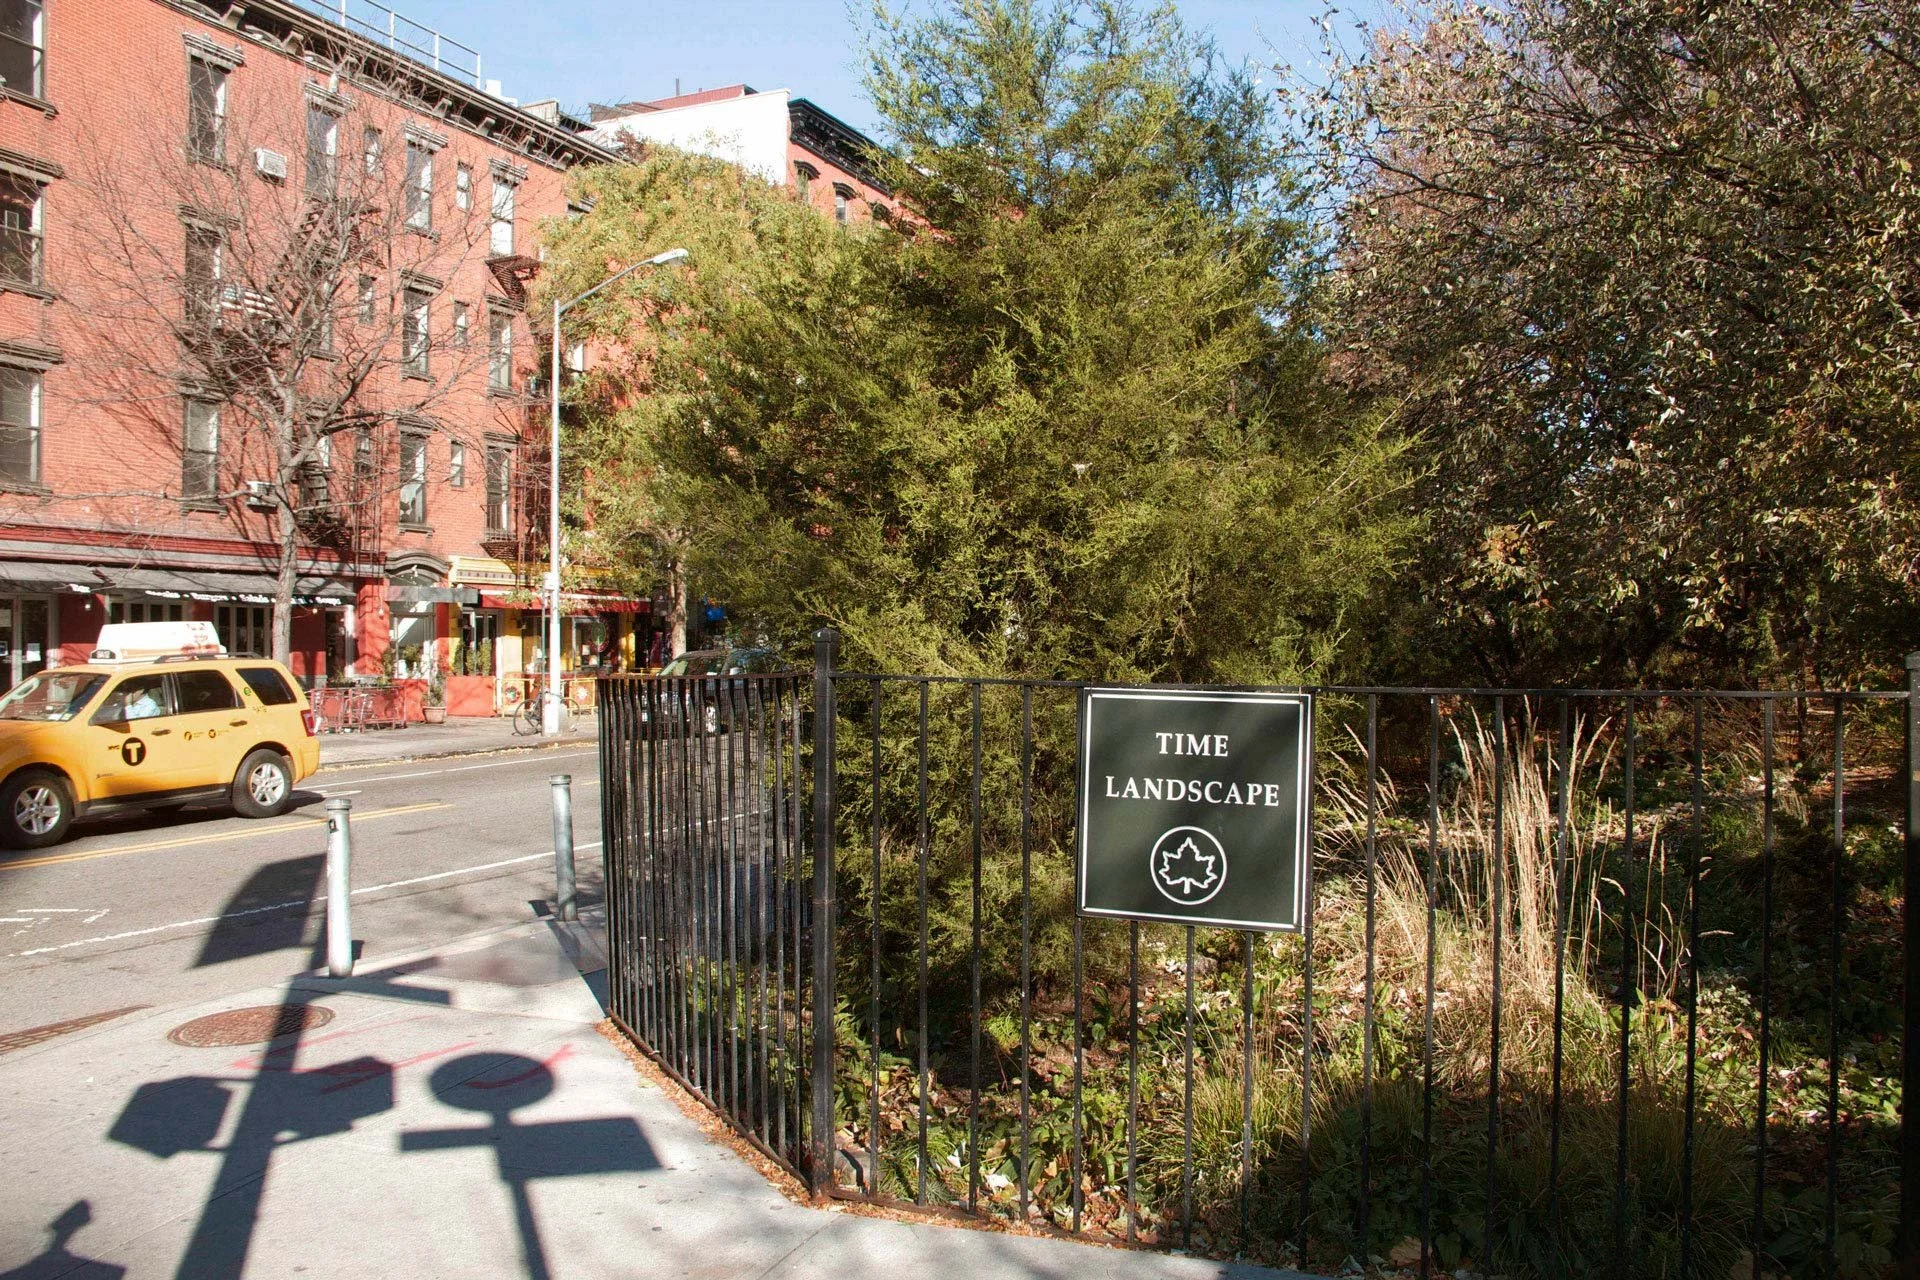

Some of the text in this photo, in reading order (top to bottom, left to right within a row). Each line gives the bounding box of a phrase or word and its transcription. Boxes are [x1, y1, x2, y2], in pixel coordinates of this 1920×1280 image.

[125, 741, 142, 763] T
[1156, 732, 1229, 757] TIME
[1105, 775, 1280, 807] LANDSCAPE
